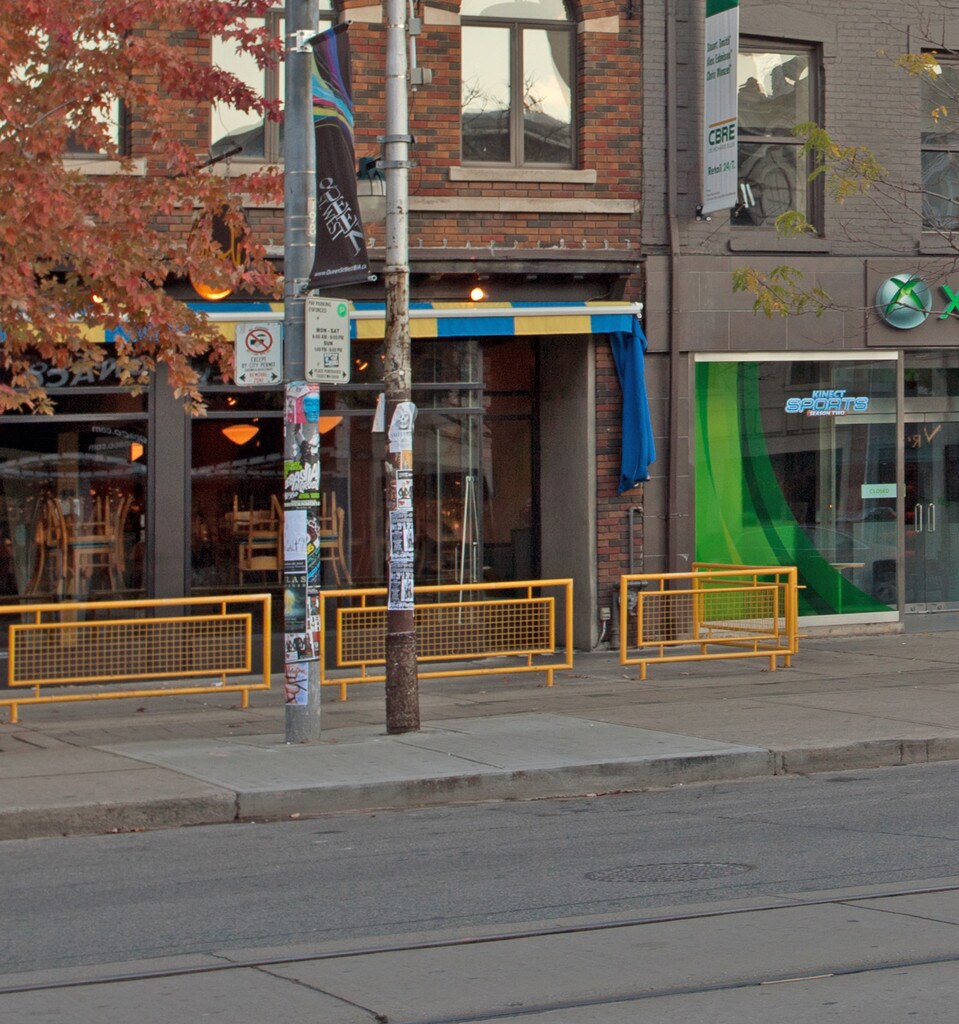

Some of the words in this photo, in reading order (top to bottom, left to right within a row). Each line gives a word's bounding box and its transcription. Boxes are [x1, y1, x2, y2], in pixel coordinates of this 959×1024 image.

[708, 123, 736, 146] CBRE
[708, 163, 722, 176] Retail
[322, 202, 345, 241] WEST
[812, 390, 846, 398] KINECT
[785, 396, 869, 414] SPORTS
